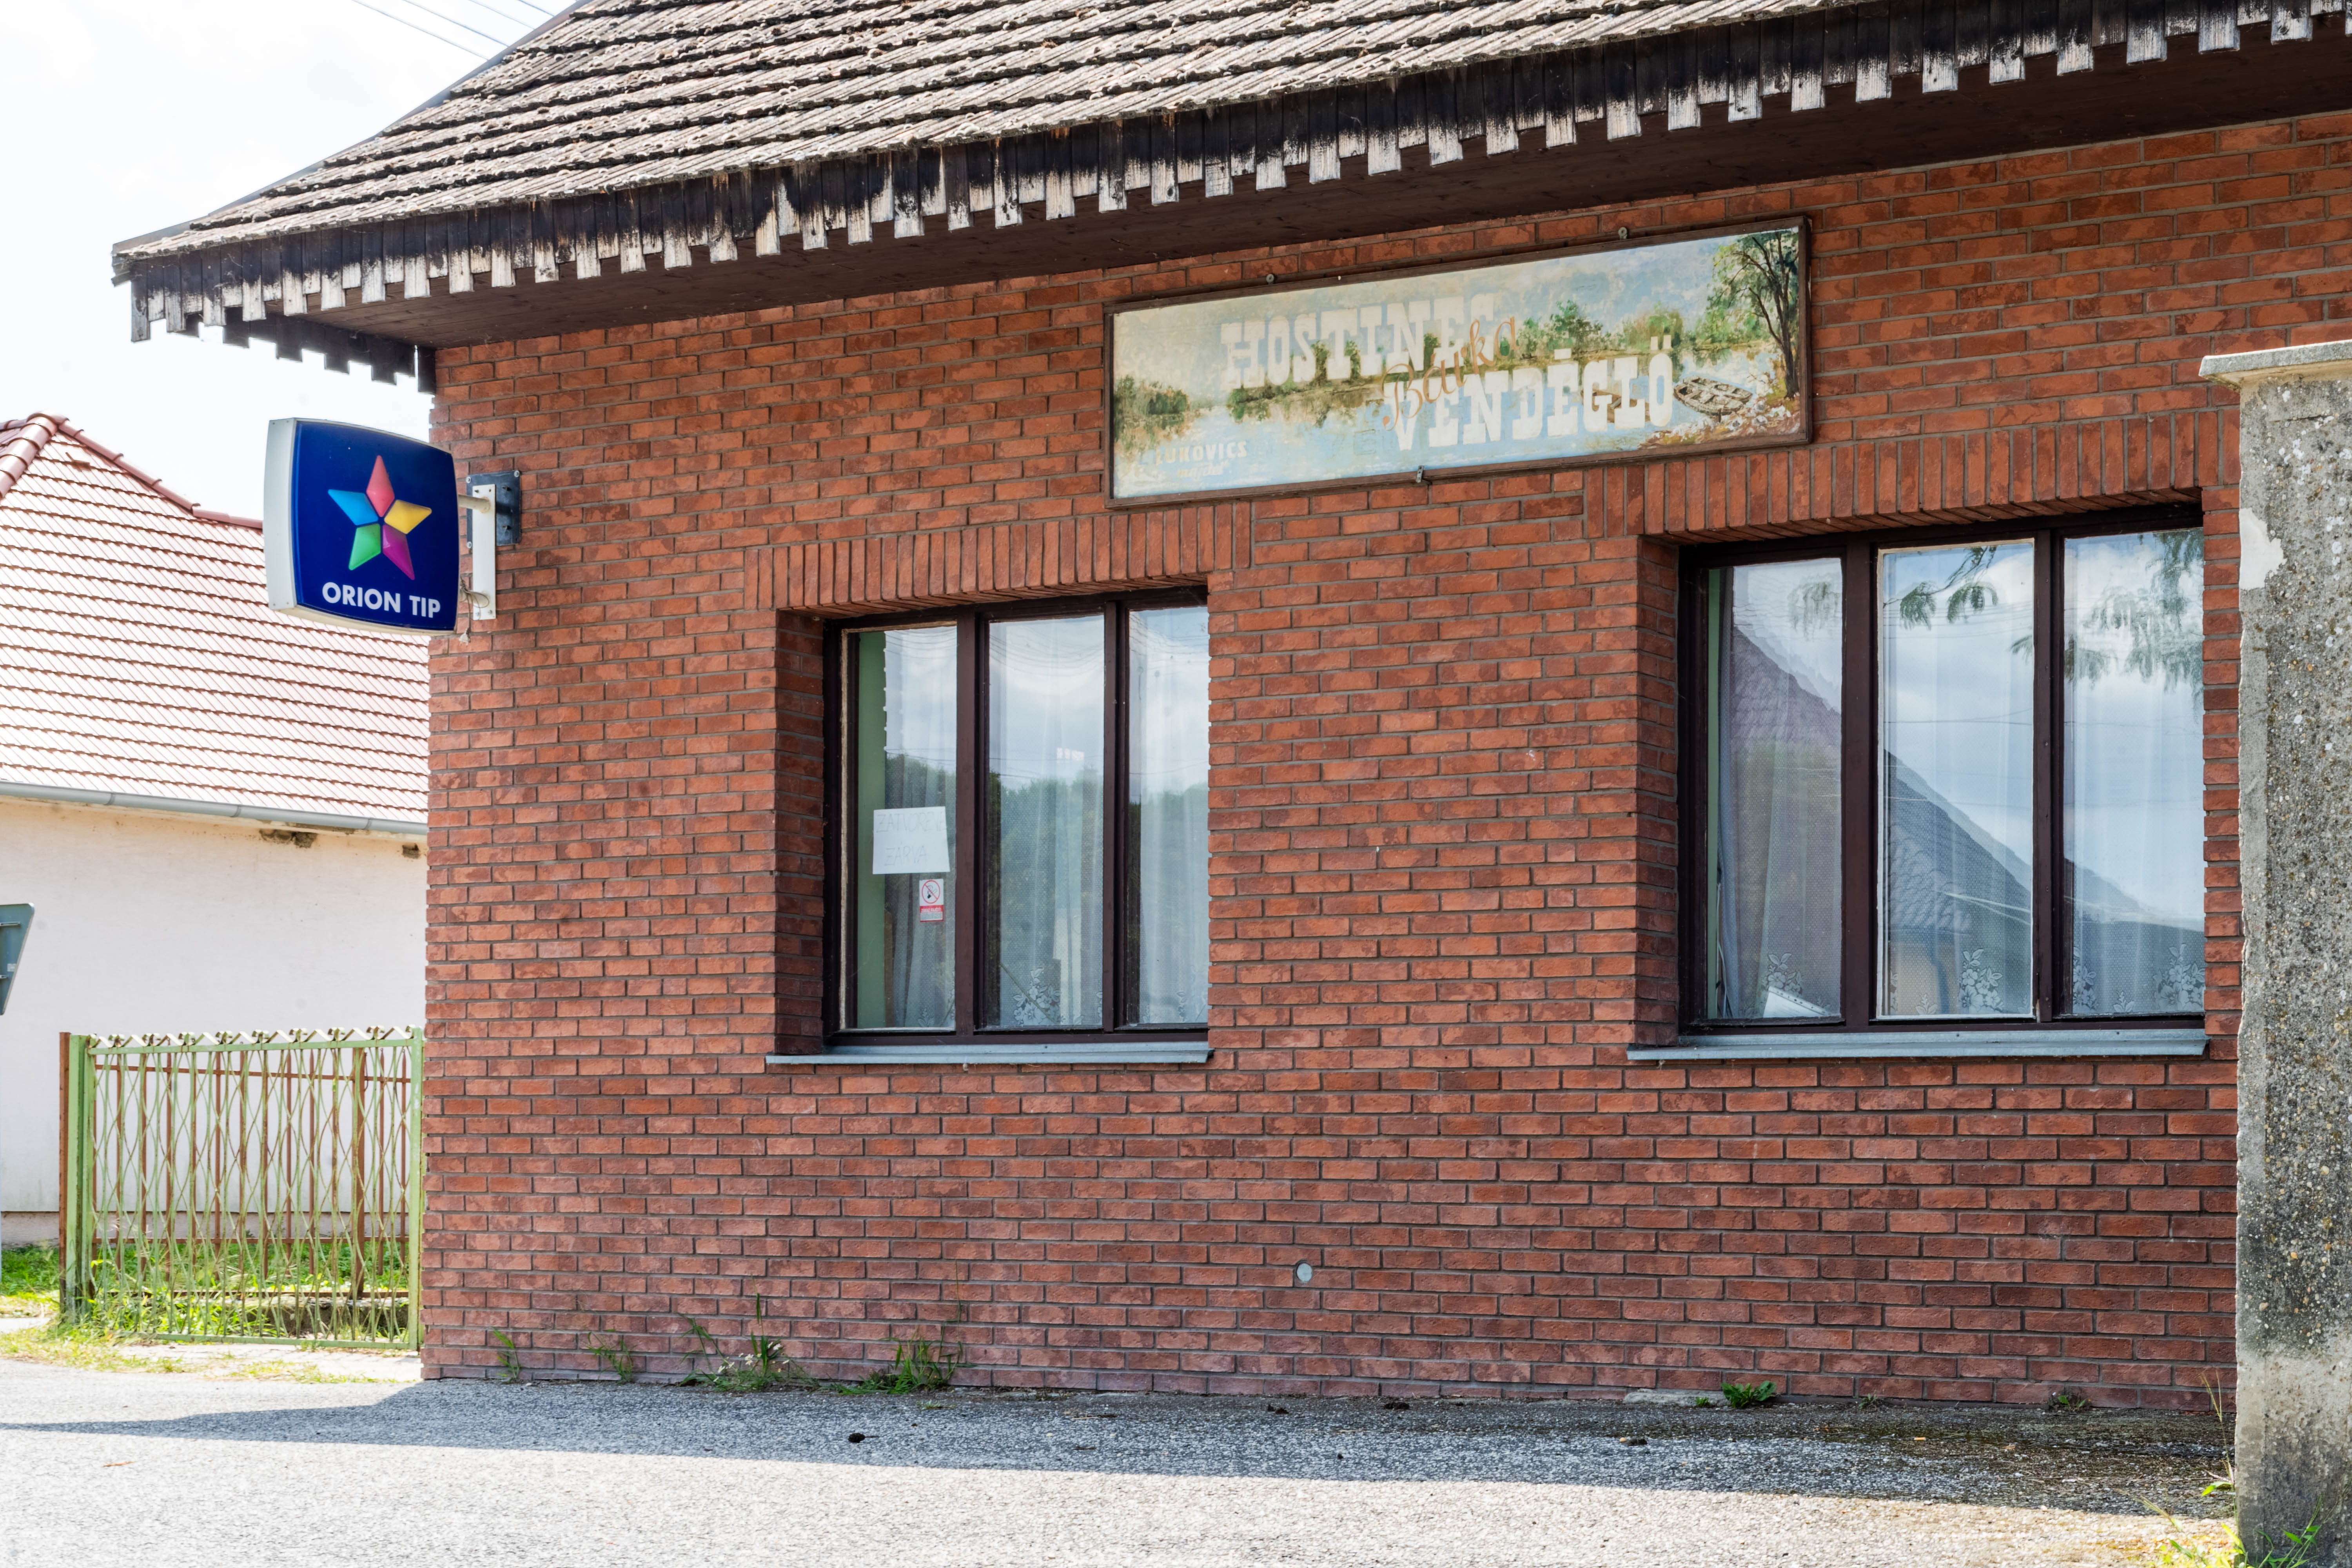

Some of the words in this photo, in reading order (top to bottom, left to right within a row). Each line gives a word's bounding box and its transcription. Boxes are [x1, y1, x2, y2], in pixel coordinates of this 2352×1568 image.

[1220, 293, 1494, 392] HOSTINEC
[1156, 441, 1247, 465] LUKOVICS
[322, 582, 400, 613] ORION
[409, 595, 440, 618] TIP
